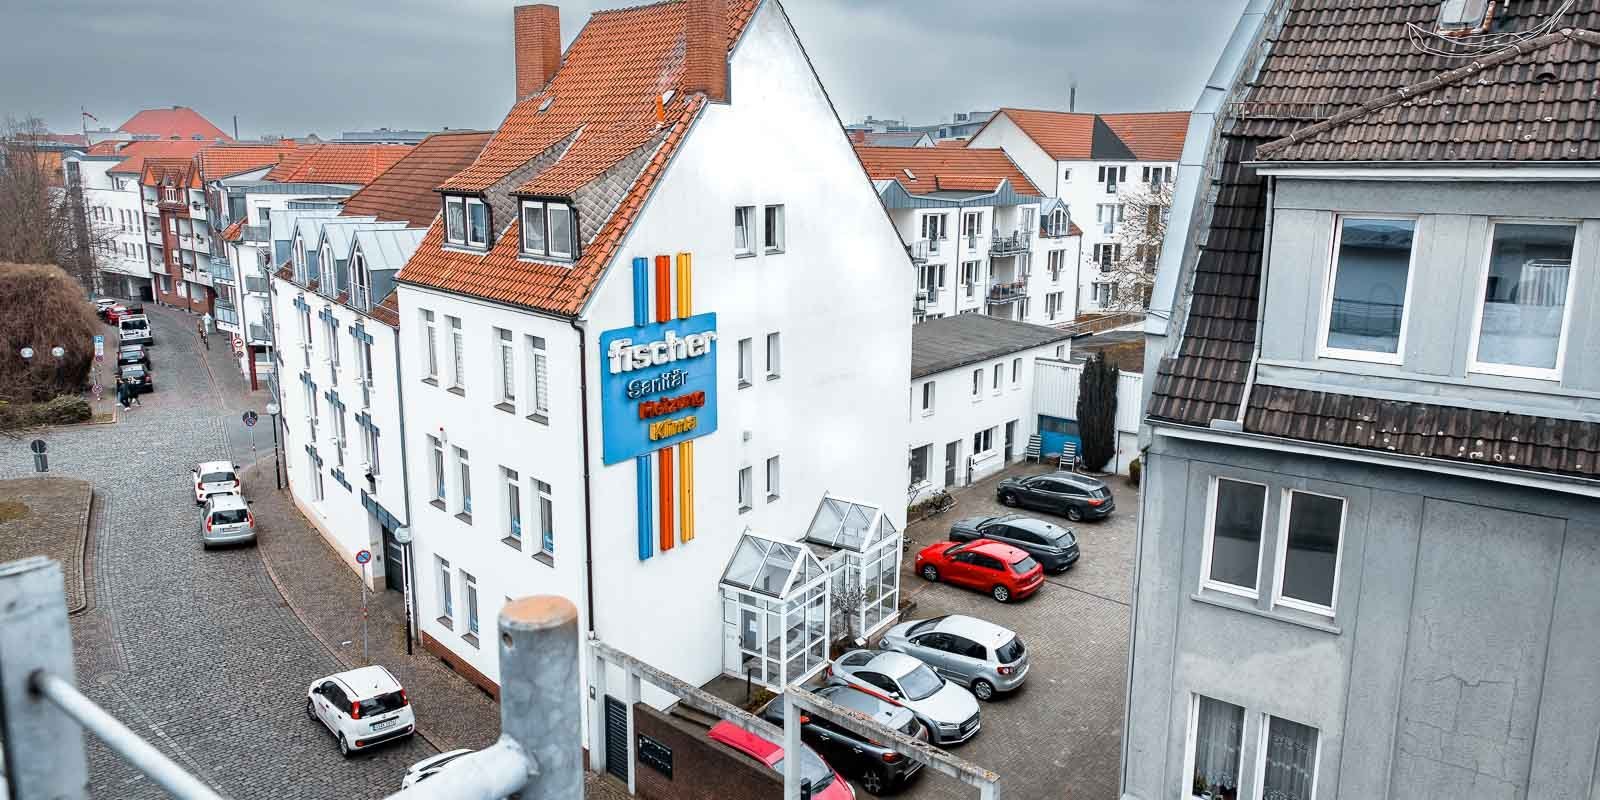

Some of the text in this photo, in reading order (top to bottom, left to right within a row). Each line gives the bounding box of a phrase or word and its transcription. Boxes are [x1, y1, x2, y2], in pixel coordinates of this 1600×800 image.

[608, 329, 717, 374] fischer
[628, 368, 688, 398] Sanitär
[649, 415, 697, 440] Klima
